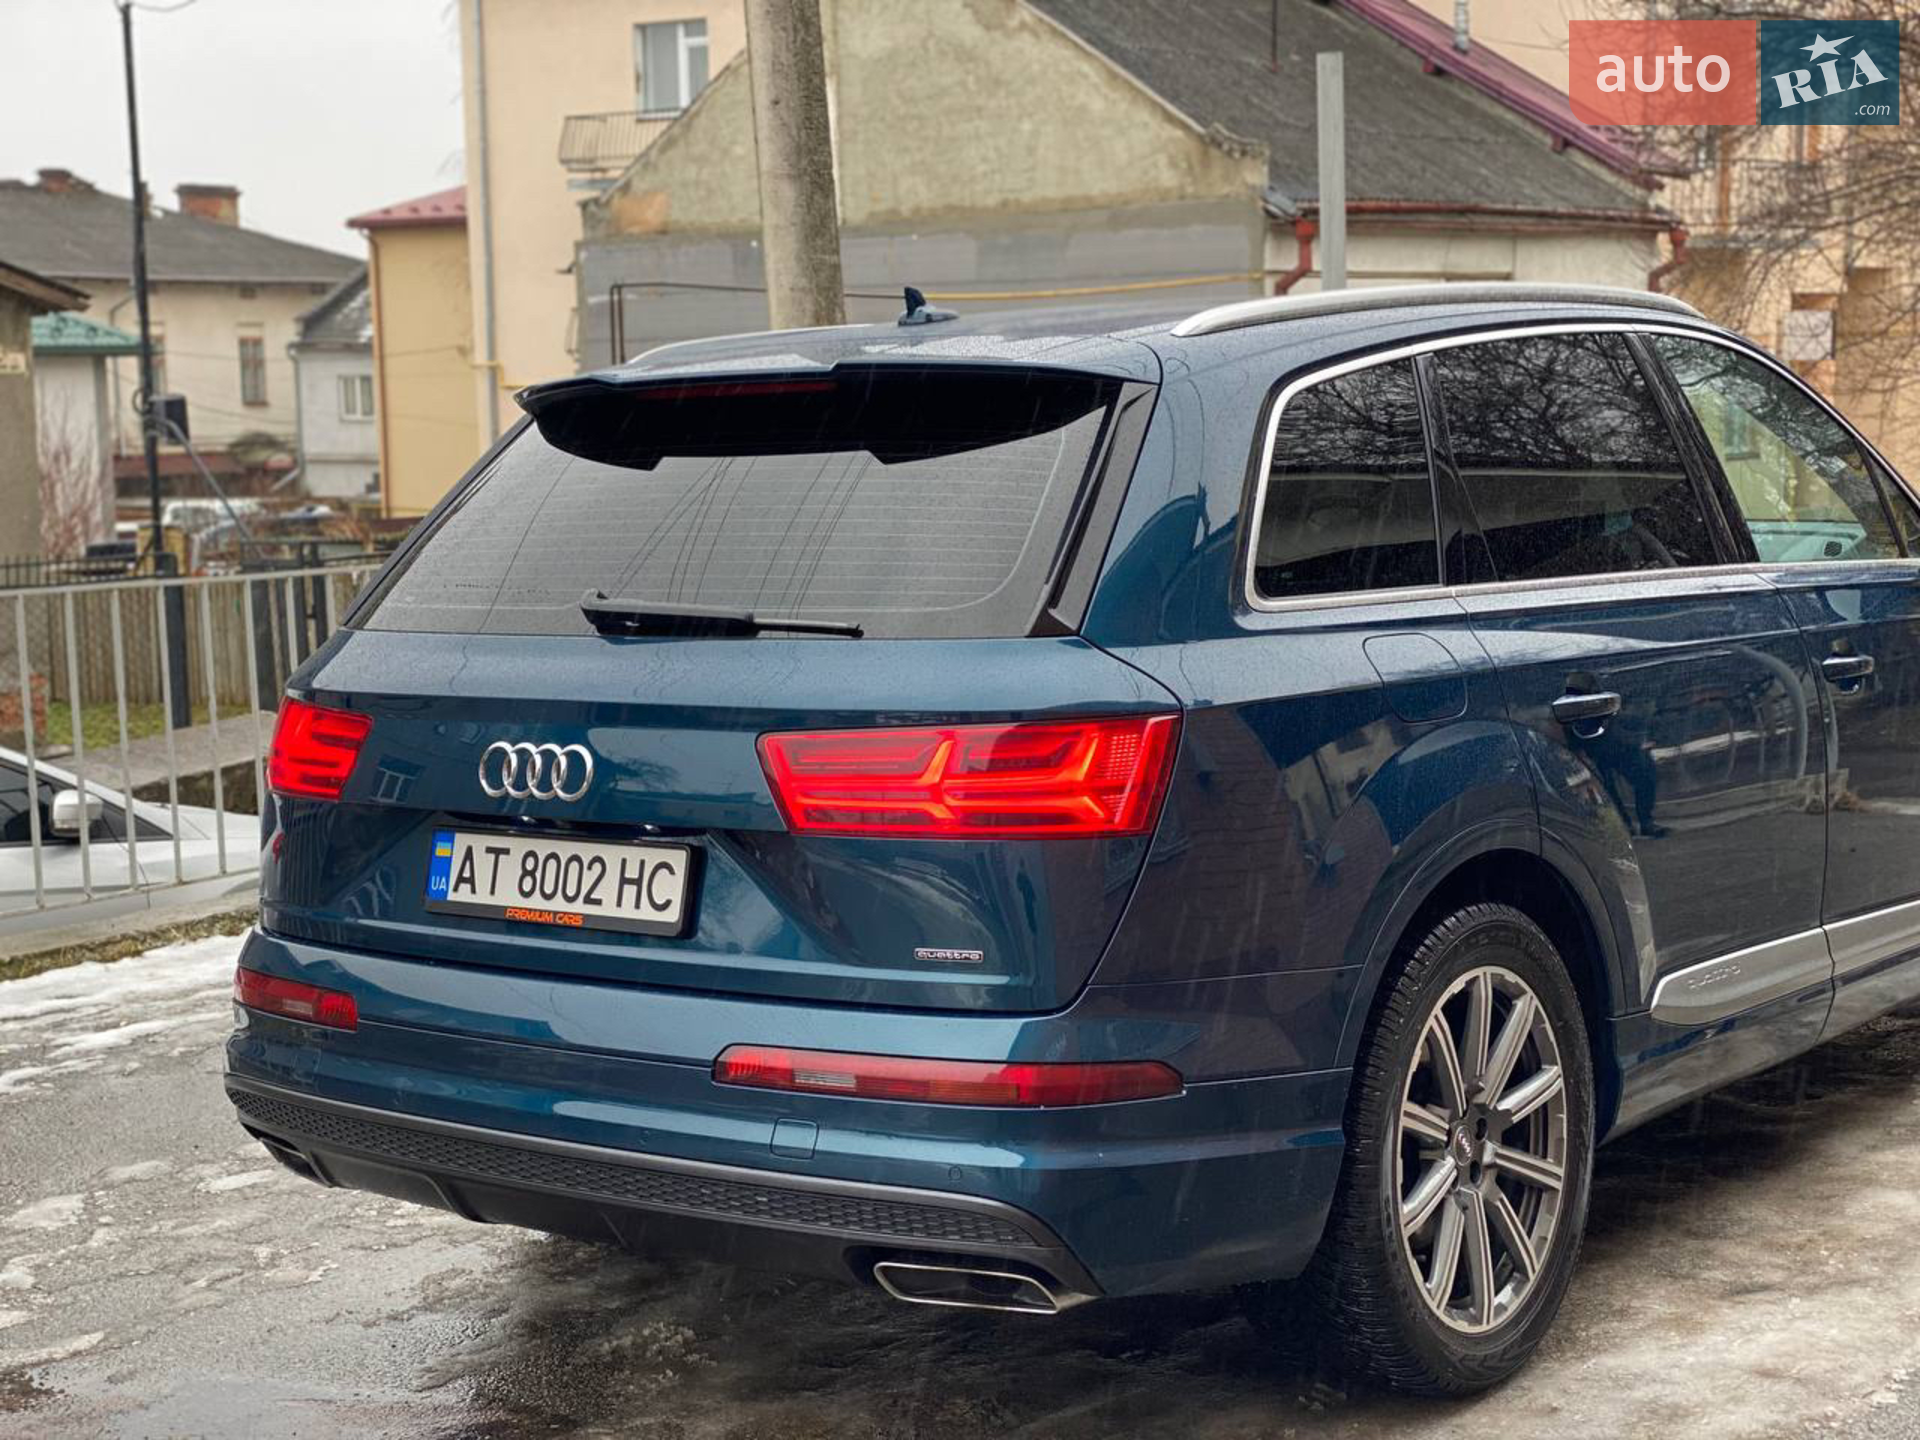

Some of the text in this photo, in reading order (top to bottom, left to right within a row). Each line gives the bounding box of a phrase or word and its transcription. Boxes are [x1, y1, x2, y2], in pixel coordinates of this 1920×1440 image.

[430, 876, 447, 891] UA
[452, 845, 676, 912] AT 8002 HC
[506, 908, 583, 926] PREMIUM CARS
[916, 950, 981, 961] quattro
